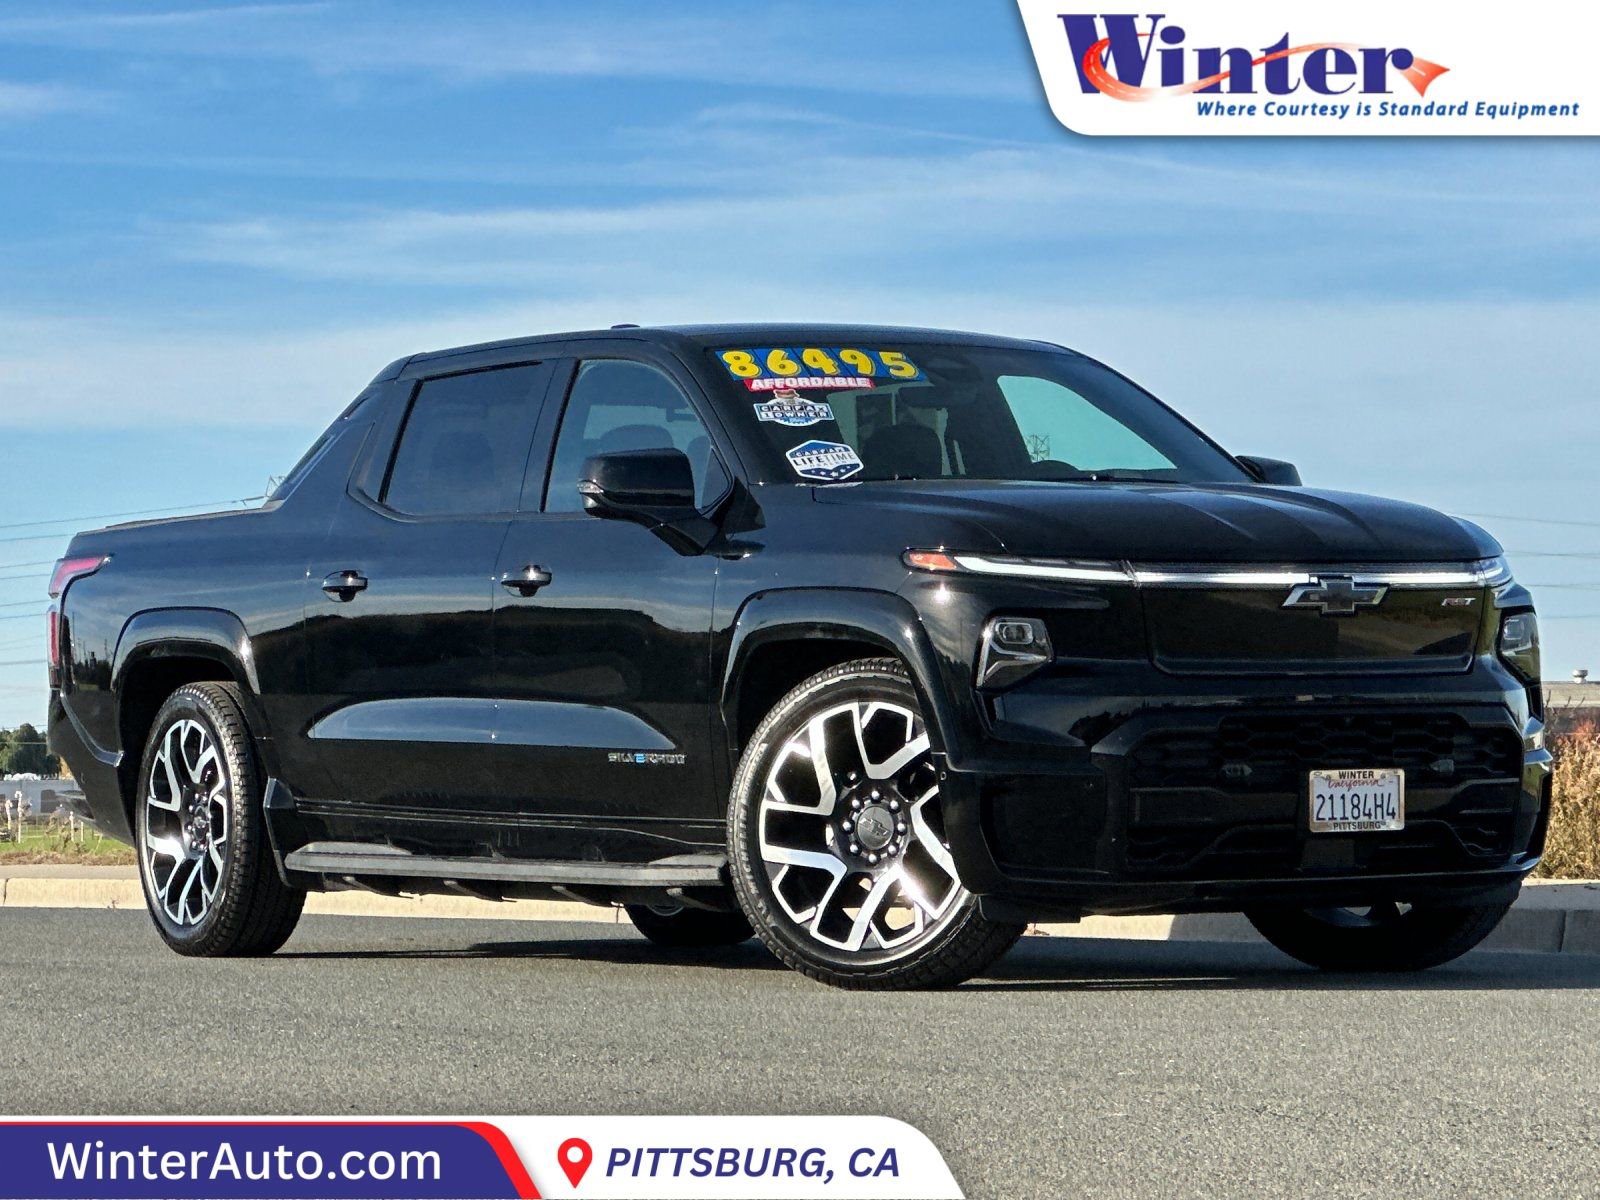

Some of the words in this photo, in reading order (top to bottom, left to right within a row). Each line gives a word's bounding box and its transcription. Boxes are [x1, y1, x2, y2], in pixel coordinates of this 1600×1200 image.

[722, 348, 918, 378] 86495
[750, 376, 868, 389] AFFORDABLE
[793, 453, 856, 466] LIFETIME
[1338, 771, 1374, 780] WINTER
[1328, 780, 1385, 791] California
[1316, 793, 1396, 820] 21184H4
[1333, 821, 1381, 830] PITTSBURG
